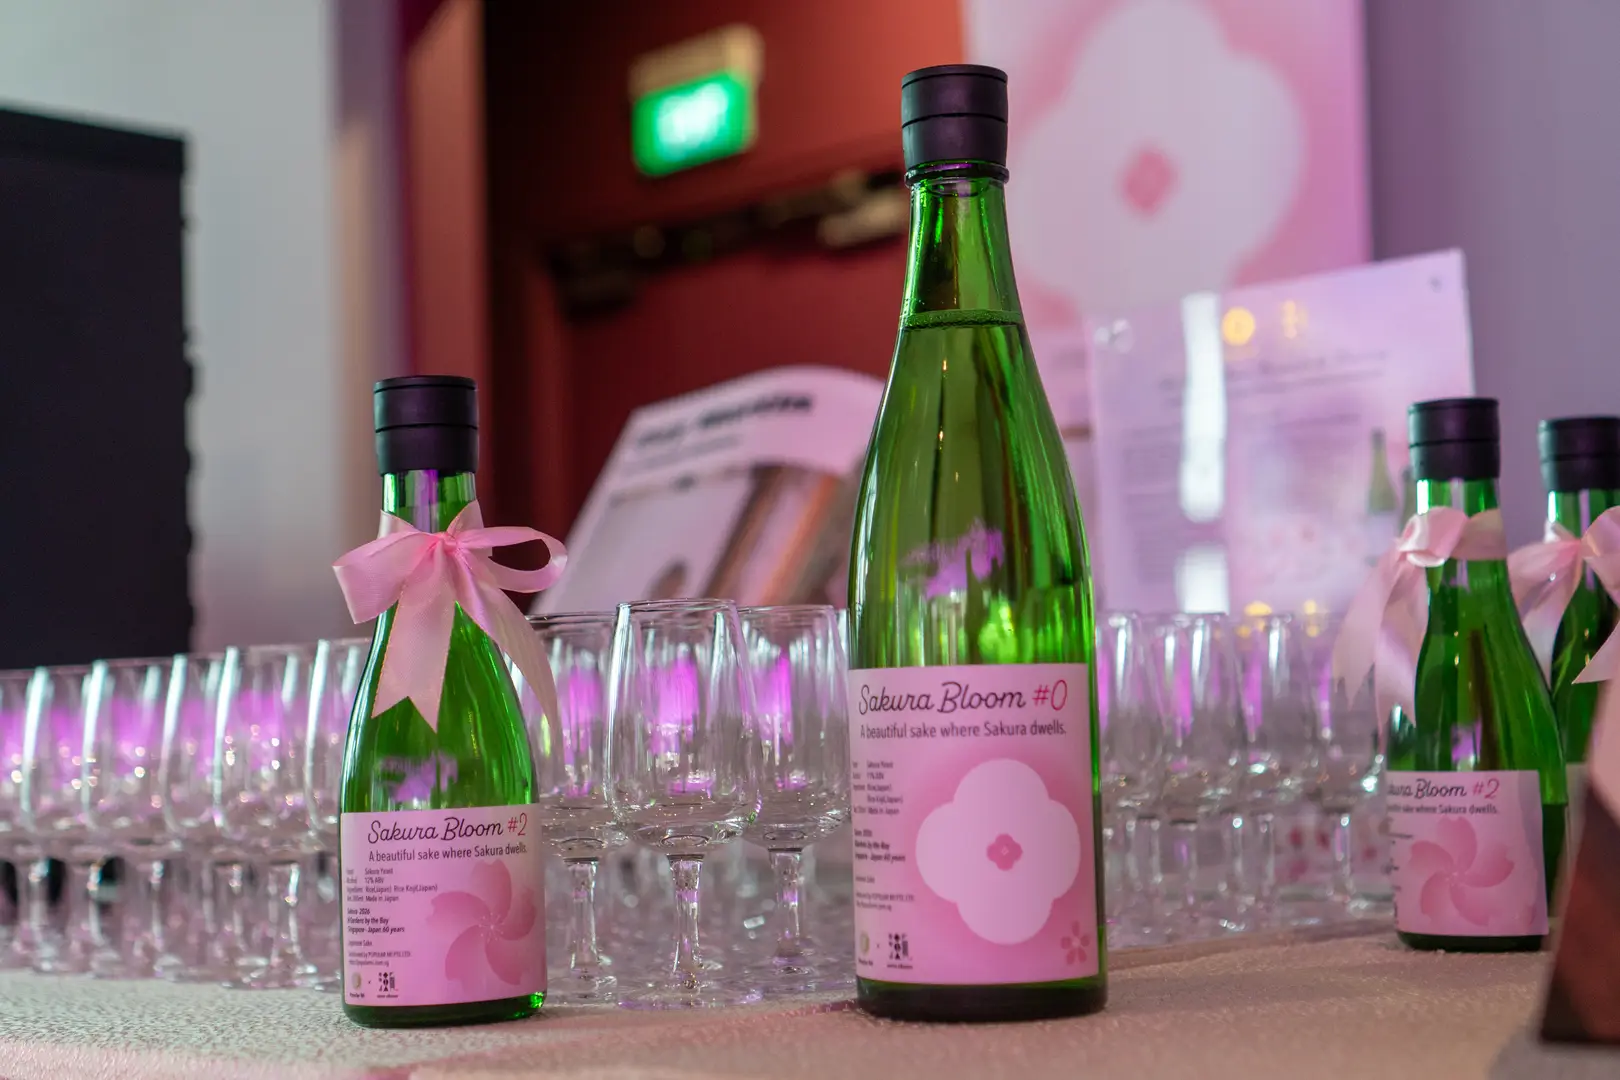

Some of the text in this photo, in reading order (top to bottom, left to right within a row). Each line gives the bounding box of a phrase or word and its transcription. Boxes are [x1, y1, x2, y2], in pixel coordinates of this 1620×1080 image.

[859, 679, 1068, 715] Sakura Bloom #0
[860, 719, 1066, 739] A beautiful sake where Sakura dwells.
[1414, 778, 1467, 799] Bloom
[1473, 778, 1500, 800] #2
[1439, 804, 1467, 814] Sakura
[368, 812, 527, 844] Sakura Bloom #2
[369, 842, 527, 862] A beautiful sake where Sakura dwells.
[390, 927, 405, 935] years
